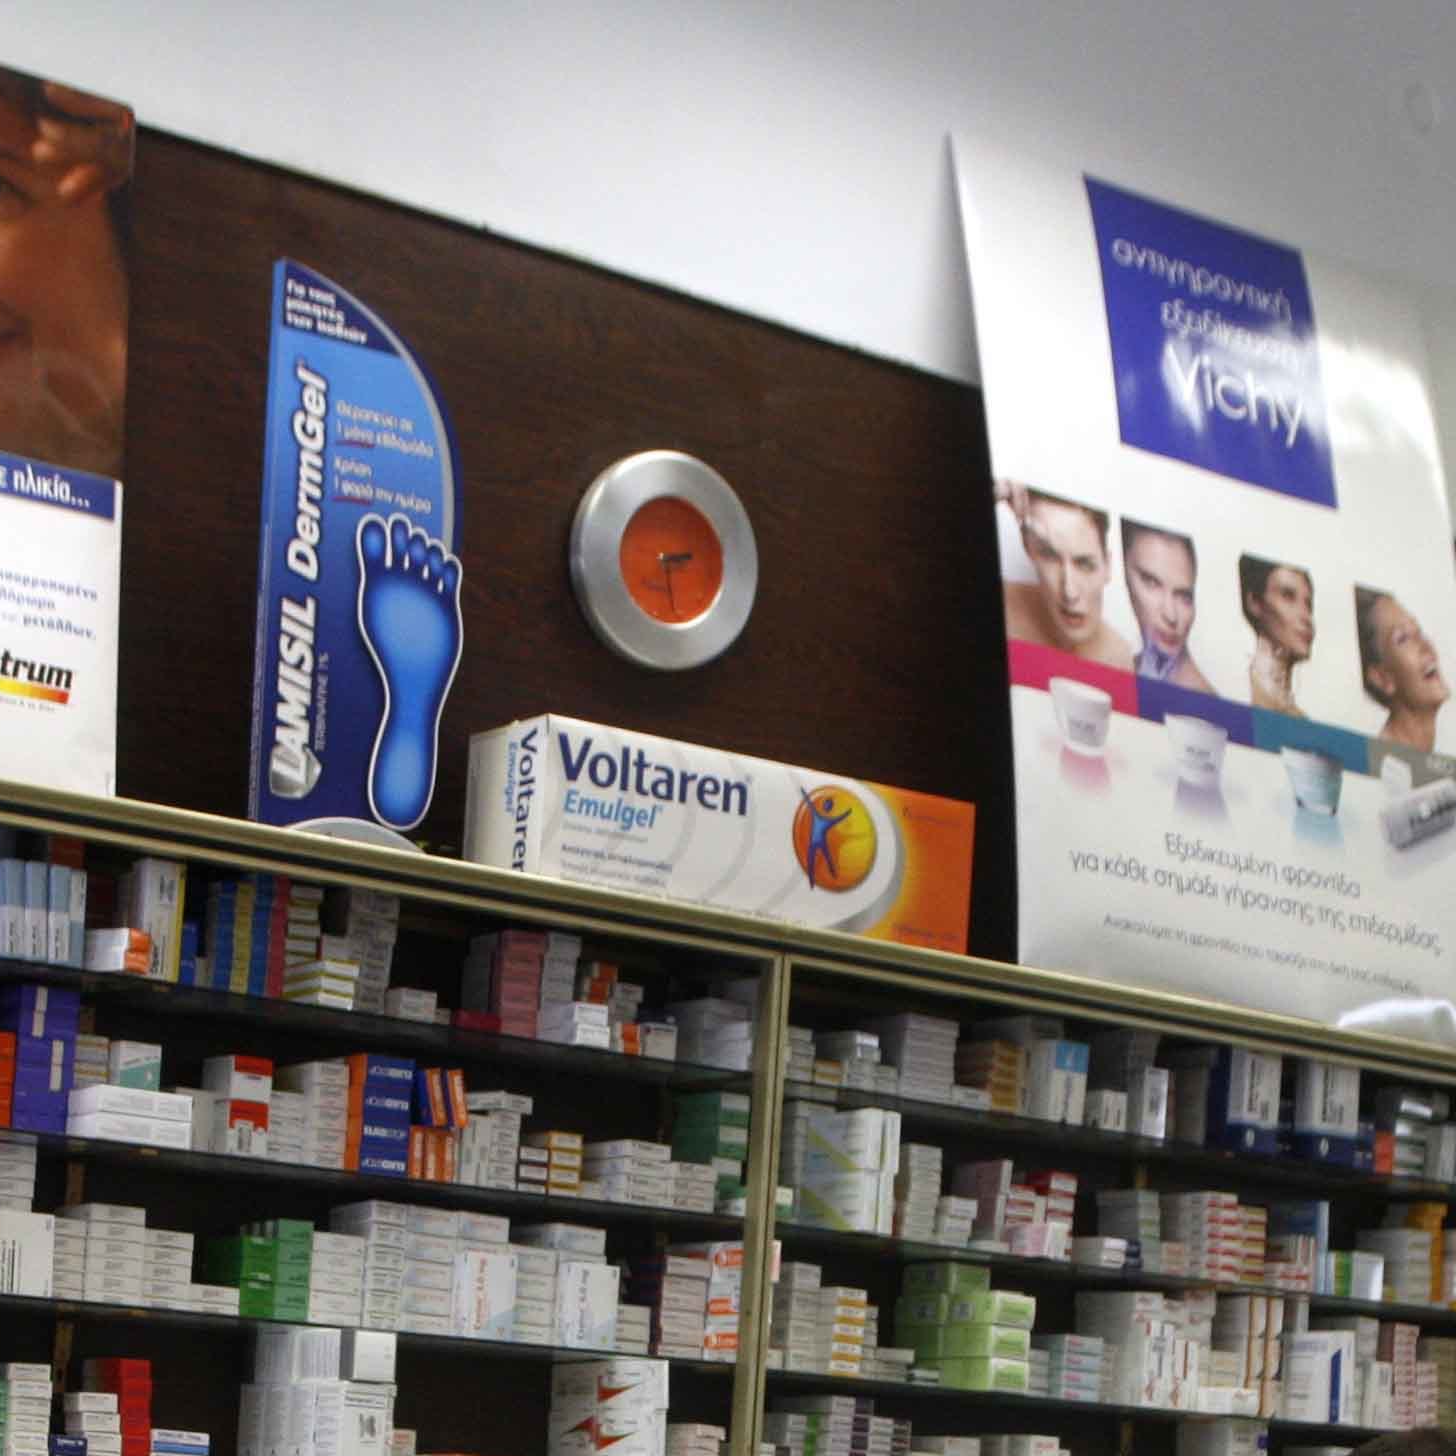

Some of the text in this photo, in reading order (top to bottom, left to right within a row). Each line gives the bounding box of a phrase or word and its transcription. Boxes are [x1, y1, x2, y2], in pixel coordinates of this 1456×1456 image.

[1164, 342, 1304, 448] Vichy
[272, 360, 328, 779] LAMISIL DermGel
[557, 731, 749, 817] Voltaren
[561, 789, 658, 832] Emulgel
